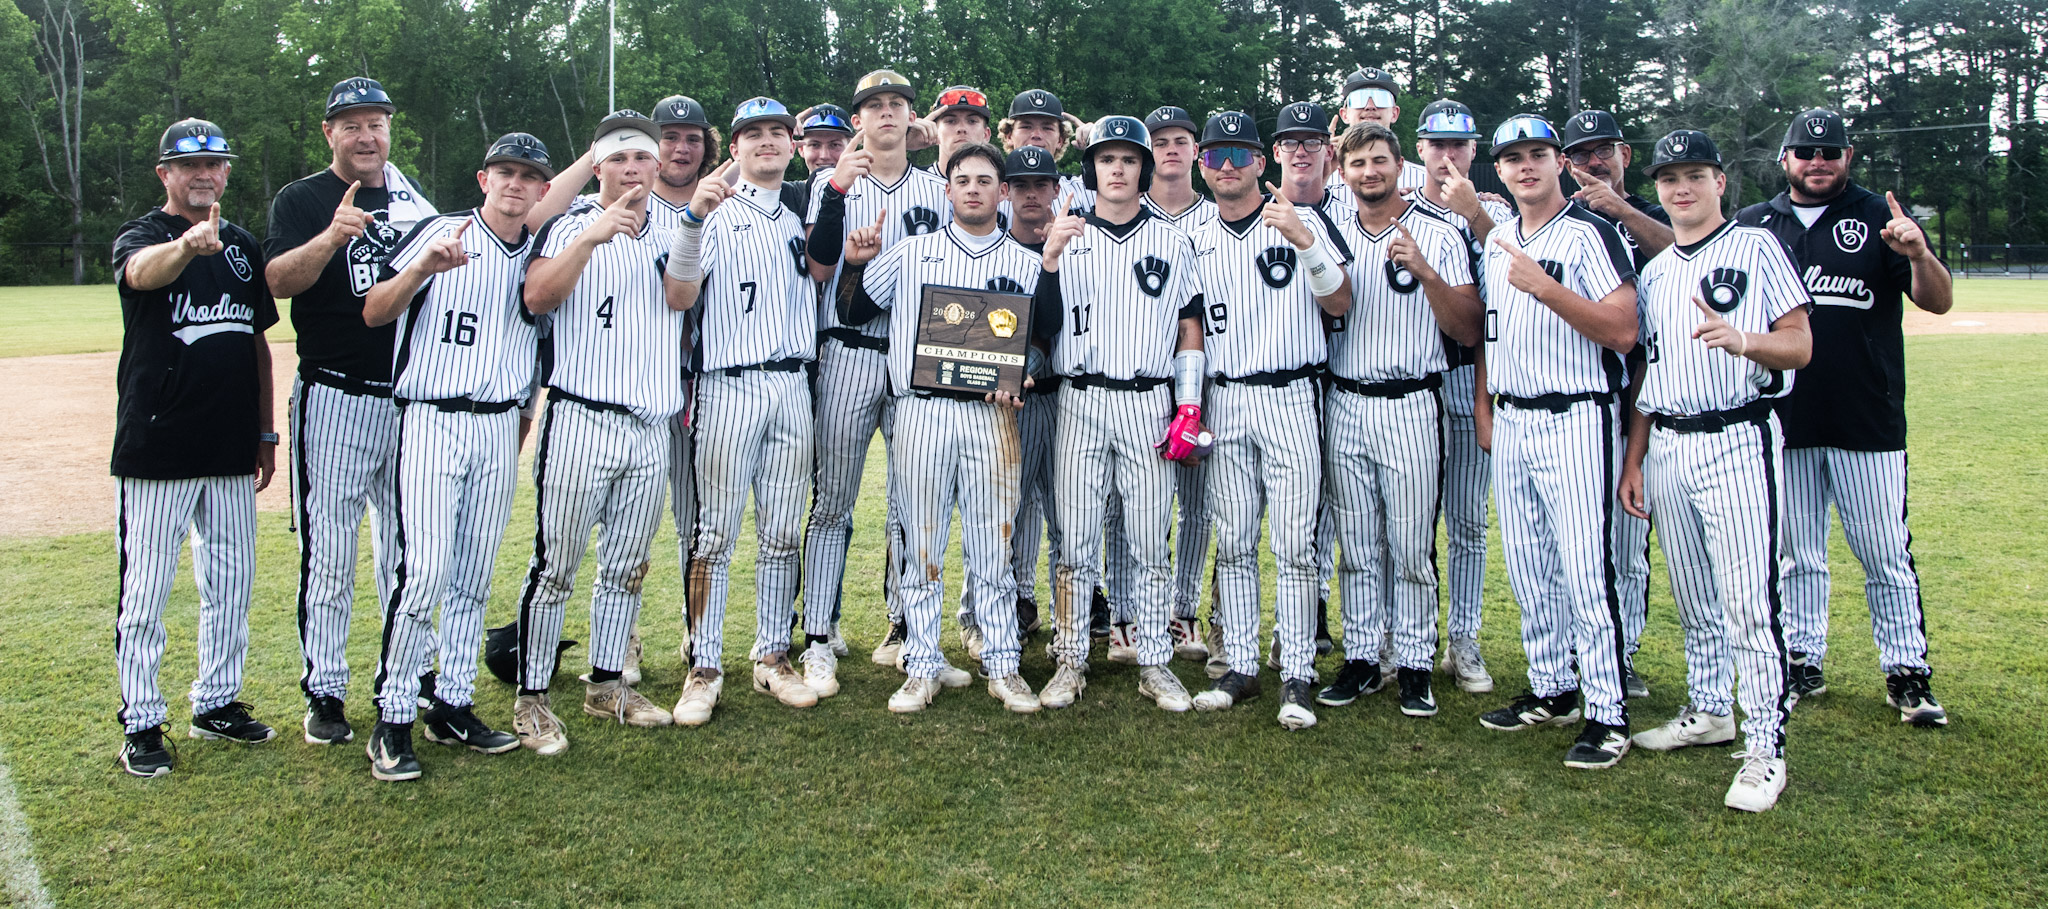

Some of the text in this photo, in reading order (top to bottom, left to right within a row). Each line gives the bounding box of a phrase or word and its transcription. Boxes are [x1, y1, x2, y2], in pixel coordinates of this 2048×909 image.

[169, 289, 254, 324] Woodlaw
[596, 295, 614, 328] 4
[740, 282, 757, 314] 7
[933, 307, 975, 320] 20 26
[441, 309, 478, 347] 16
[1072, 303, 1091, 337] 11
[1203, 303, 1228, 336] 19
[924, 347, 1019, 364] CHAMPIONS
[960, 365, 998, 376] REGIONAL
[973, 374, 996, 382] BASEBALL
